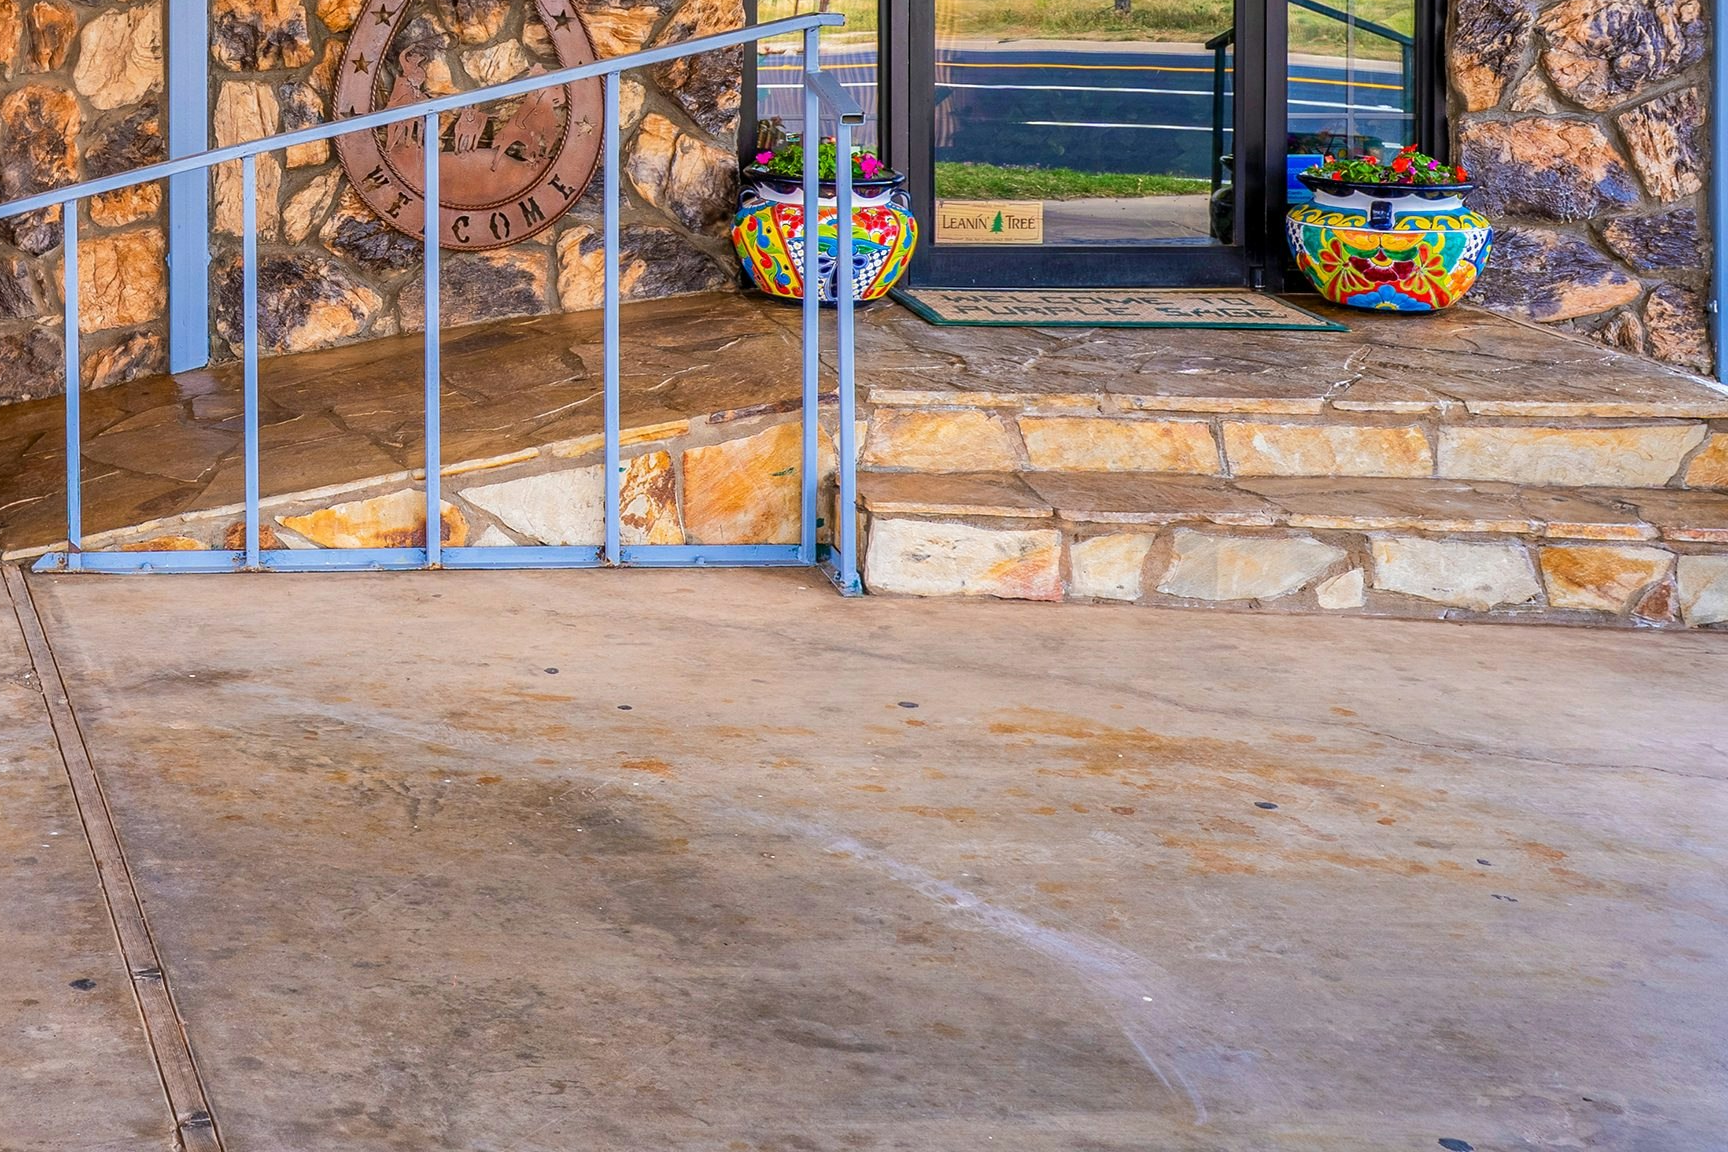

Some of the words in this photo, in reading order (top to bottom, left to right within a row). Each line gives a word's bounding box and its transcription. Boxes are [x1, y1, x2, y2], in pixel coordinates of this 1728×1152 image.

[362, 165, 575, 243] WECOME
[1005, 215, 1036, 229] TREE
[943, 295, 1173, 306] WELCOME
[1195, 297, 1255, 306] TO
[958, 306, 1140, 315] PURPLE
